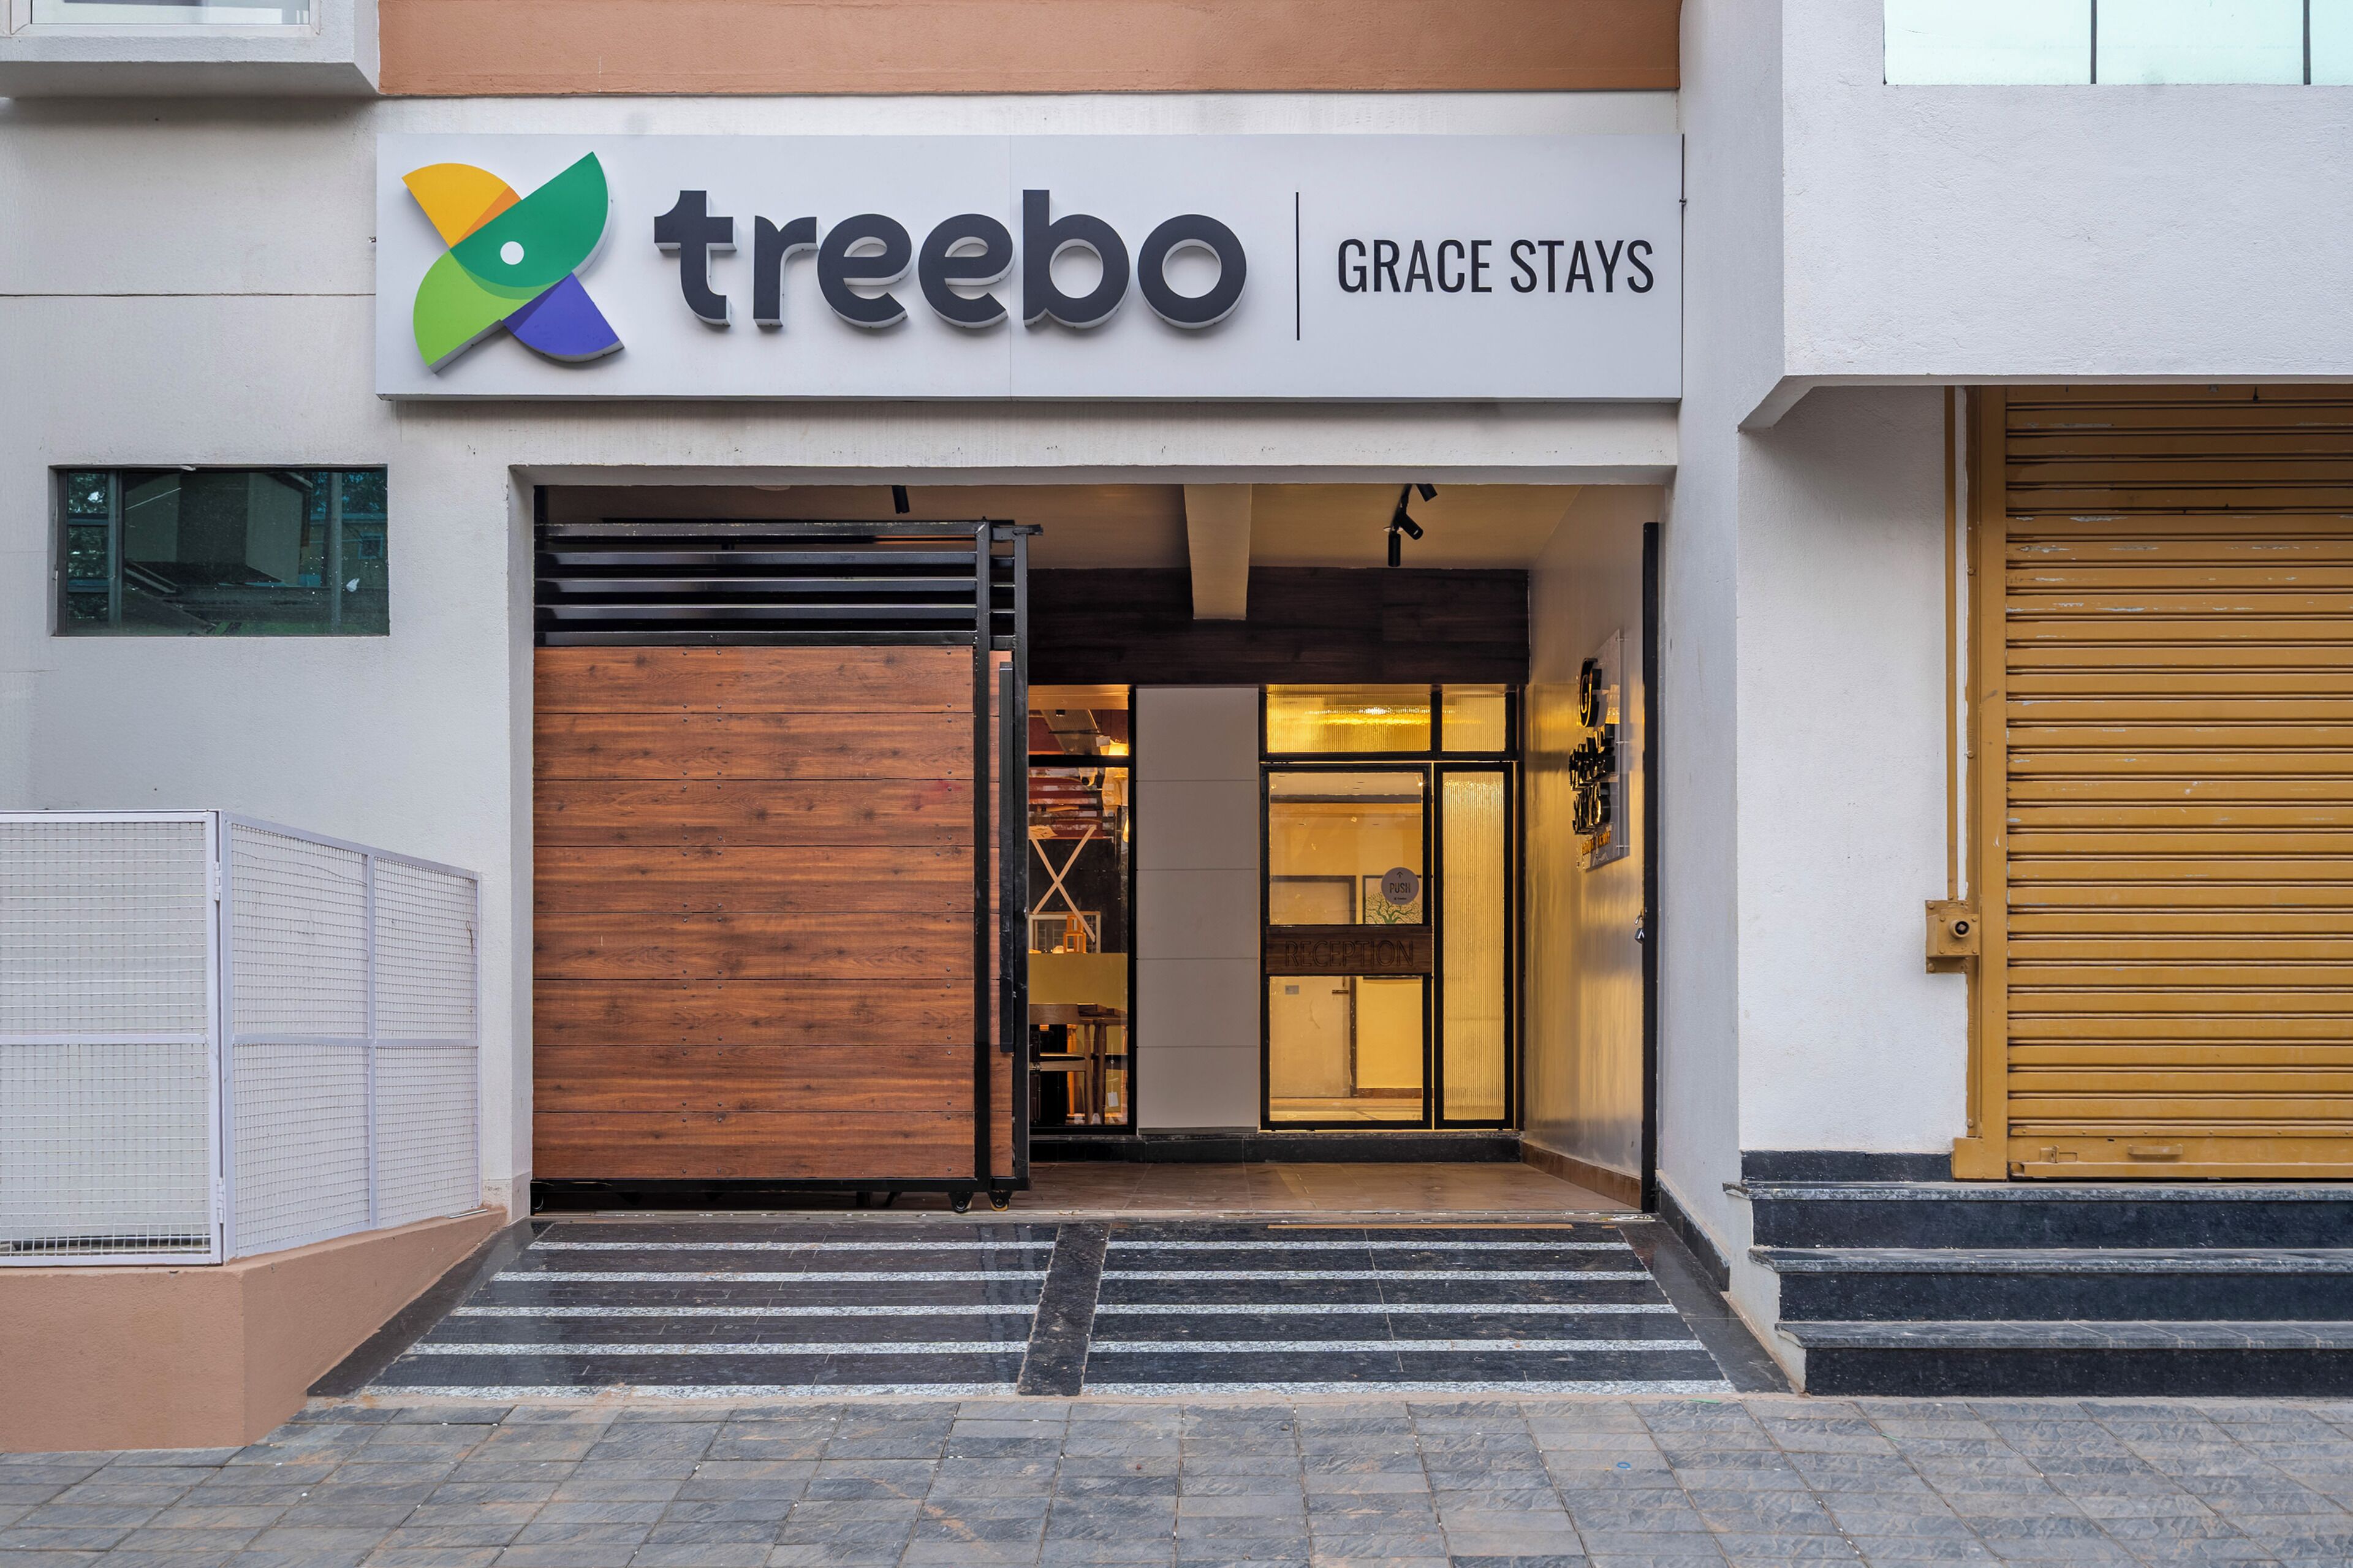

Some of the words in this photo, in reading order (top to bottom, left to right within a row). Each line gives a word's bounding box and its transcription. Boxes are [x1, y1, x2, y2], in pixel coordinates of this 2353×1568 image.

[654, 189, 1246, 327] treebo
[1338, 238, 1493, 294] GRACE
[1510, 239, 1654, 294] STAYS
[1389, 882, 1411, 893] PUSH
[1284, 939, 1414, 967] RECEPTION
